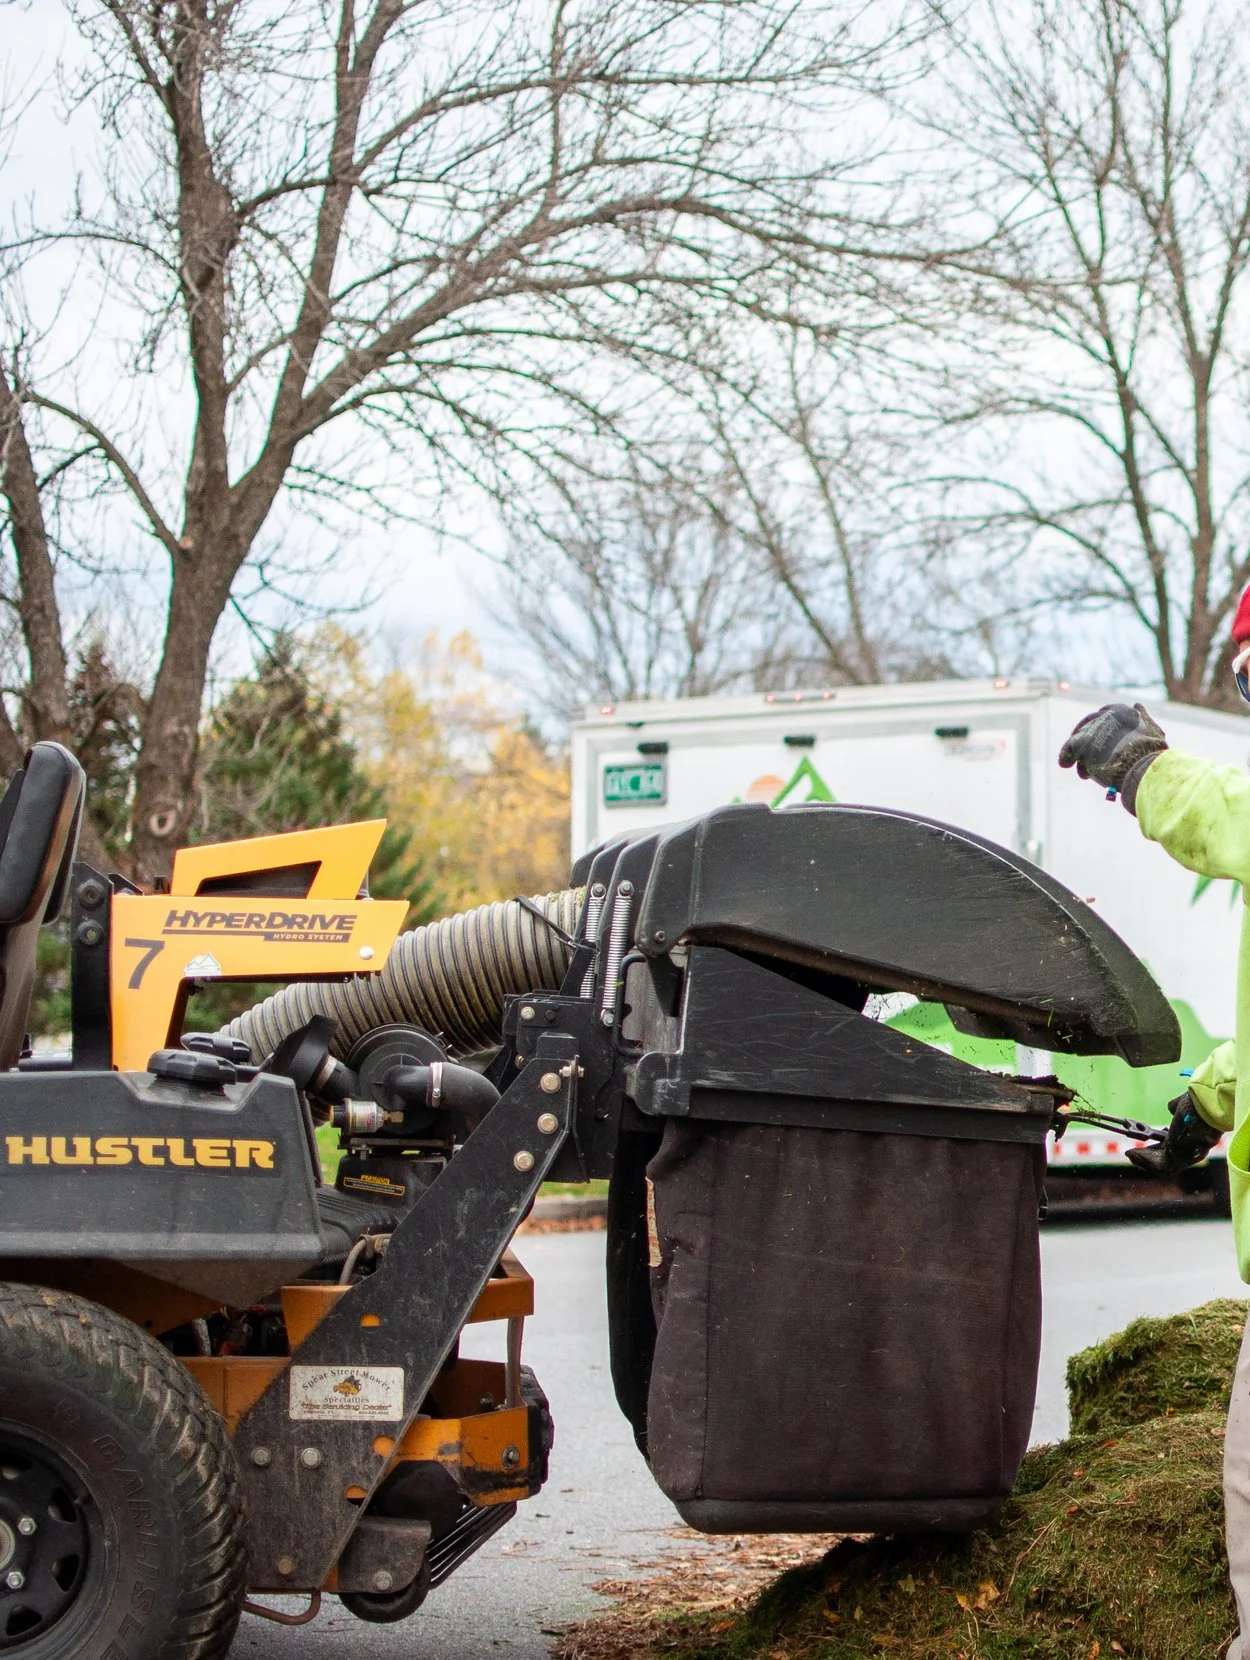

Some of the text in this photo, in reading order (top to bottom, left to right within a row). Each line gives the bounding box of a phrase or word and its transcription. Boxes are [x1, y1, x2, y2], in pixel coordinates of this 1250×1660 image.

[164, 910, 358, 931] HYPERDRIVE
[124, 938, 165, 990] 7
[5, 1136, 275, 1169] HUSTLER
[302, 1369, 390, 1391] Spear Street Mower
[324, 1396, 369, 1404] Specialties
